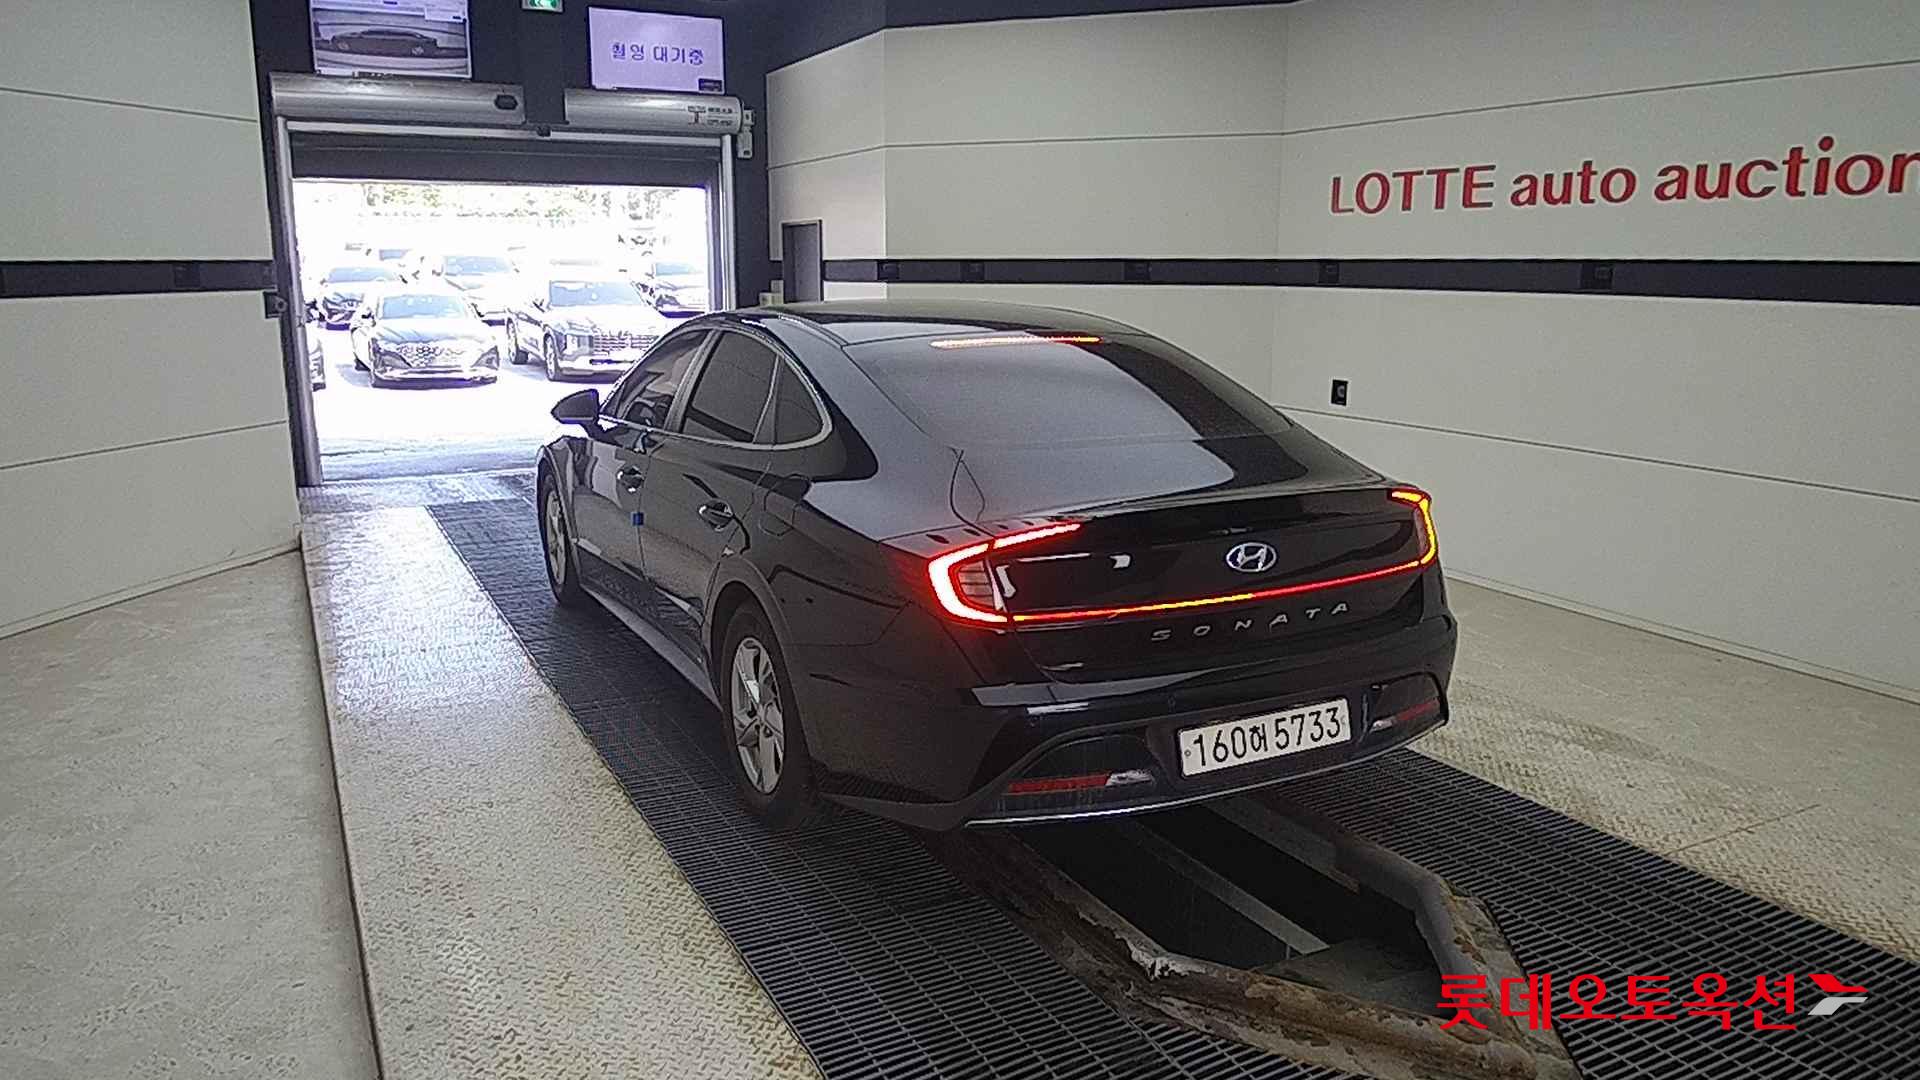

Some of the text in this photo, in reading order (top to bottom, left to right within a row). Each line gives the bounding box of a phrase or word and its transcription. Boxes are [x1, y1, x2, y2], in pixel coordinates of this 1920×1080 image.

[1331, 164, 1497, 214] LOTTE
[1511, 160, 1637, 206] auto
[1151, 603, 1348, 641] SONATA
